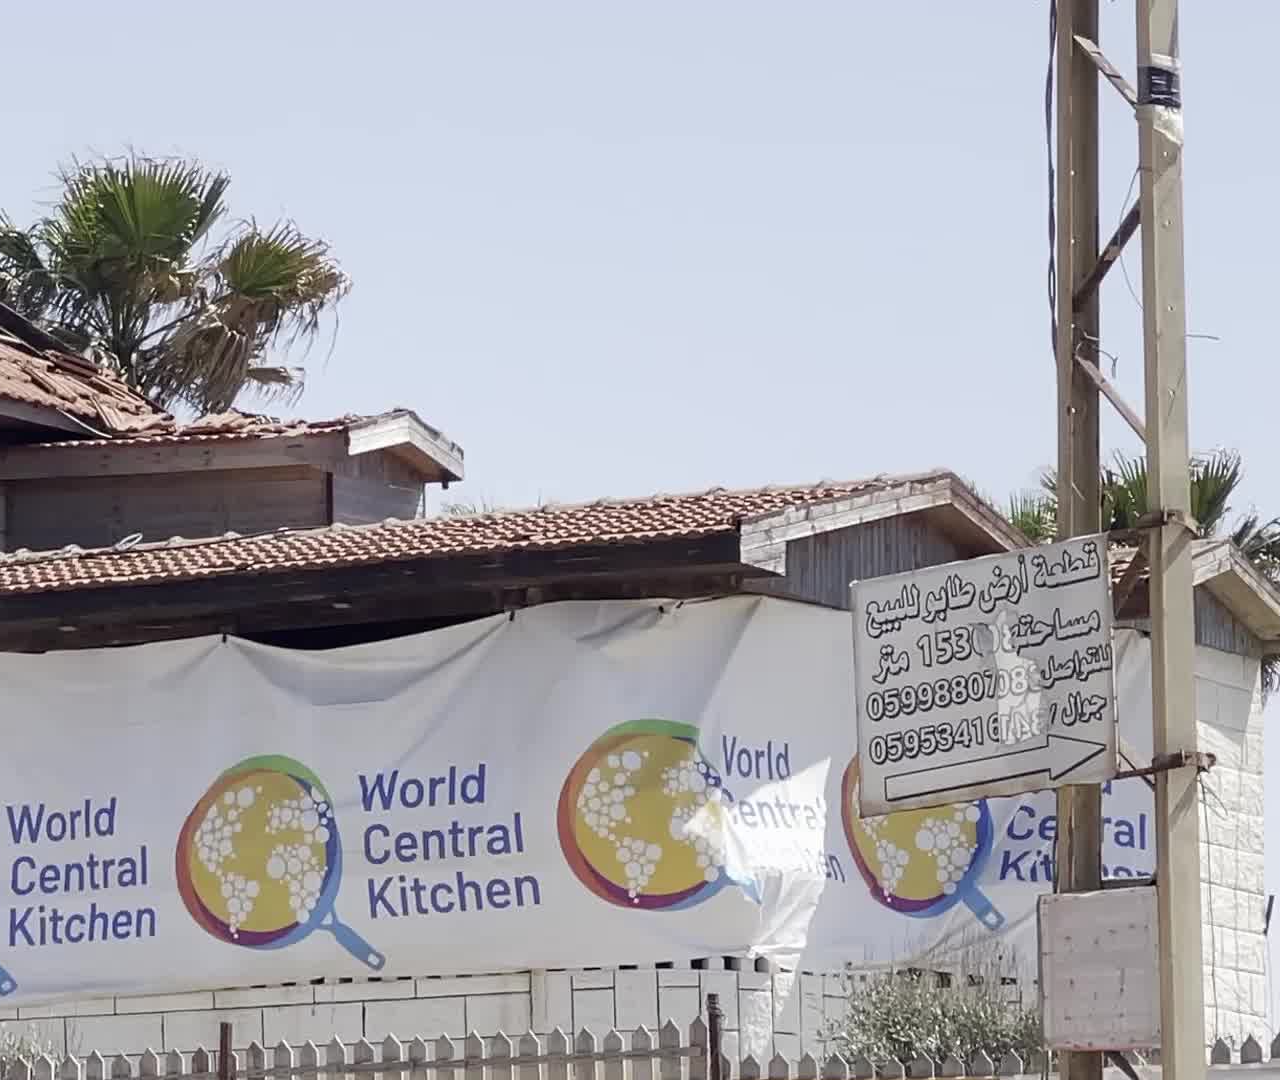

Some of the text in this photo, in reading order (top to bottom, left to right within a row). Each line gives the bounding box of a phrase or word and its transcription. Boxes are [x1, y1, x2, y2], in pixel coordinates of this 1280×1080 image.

[1033, 541, 1101, 588] قطعة
[866, 583, 920, 639] للبيع
[922, 574, 976, 624] طابو
[1009, 607, 1101, 656] مساحته
[872, 644, 910, 684] متر
[1061, 691, 1107, 727] جوال
[358, 762, 486, 812] World
[6, 797, 117, 846] World
[363, 812, 526, 863] Central
[10, 847, 149, 897] Central
[367, 868, 541, 920] Kitchen
[7, 903, 157, 948] Kitchen
